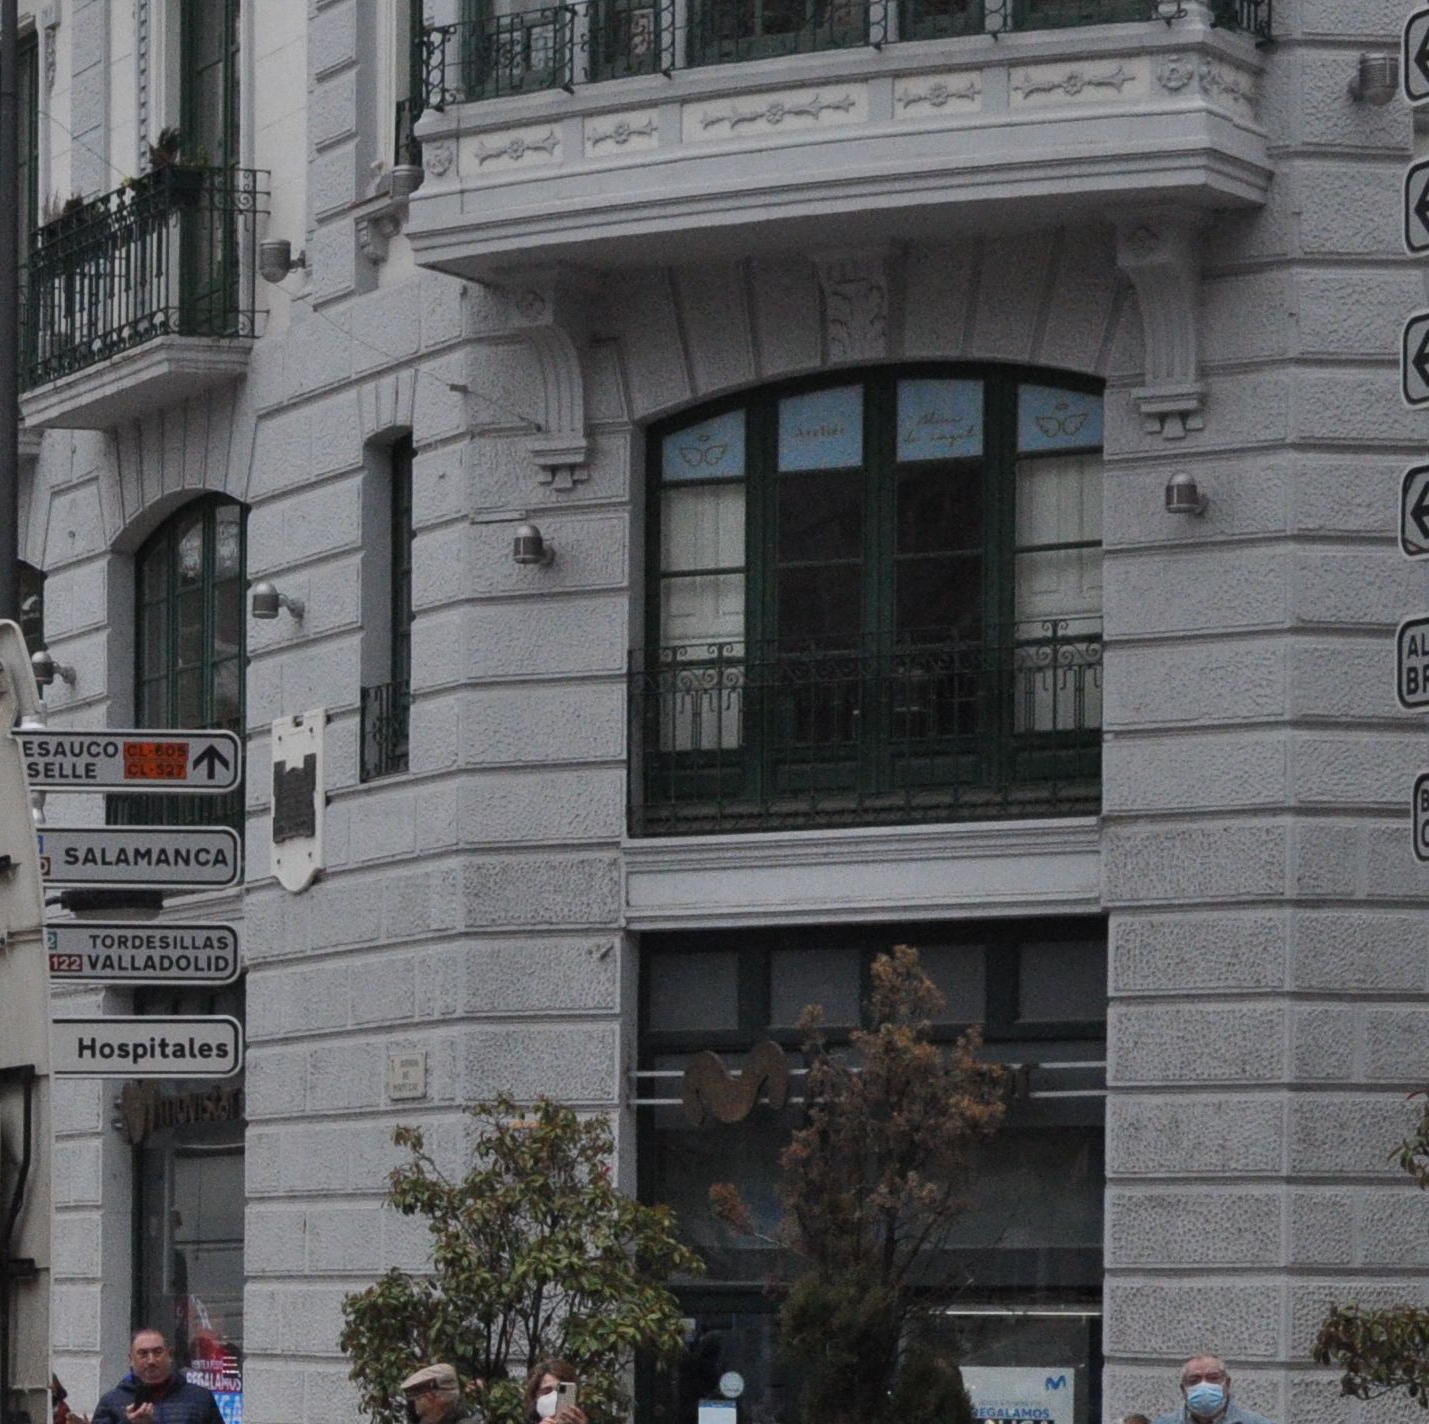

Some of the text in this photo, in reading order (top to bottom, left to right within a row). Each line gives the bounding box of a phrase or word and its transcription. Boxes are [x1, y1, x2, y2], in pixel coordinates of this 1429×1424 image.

[27, 761, 97, 779] SELLE
[64, 846, 229, 866] SALAMANCA
[89, 934, 229, 950] TORDESILLAS
[51, 954, 229, 972] 122 VALLADOLID
[78, 1036, 229, 1064] Hospitales
